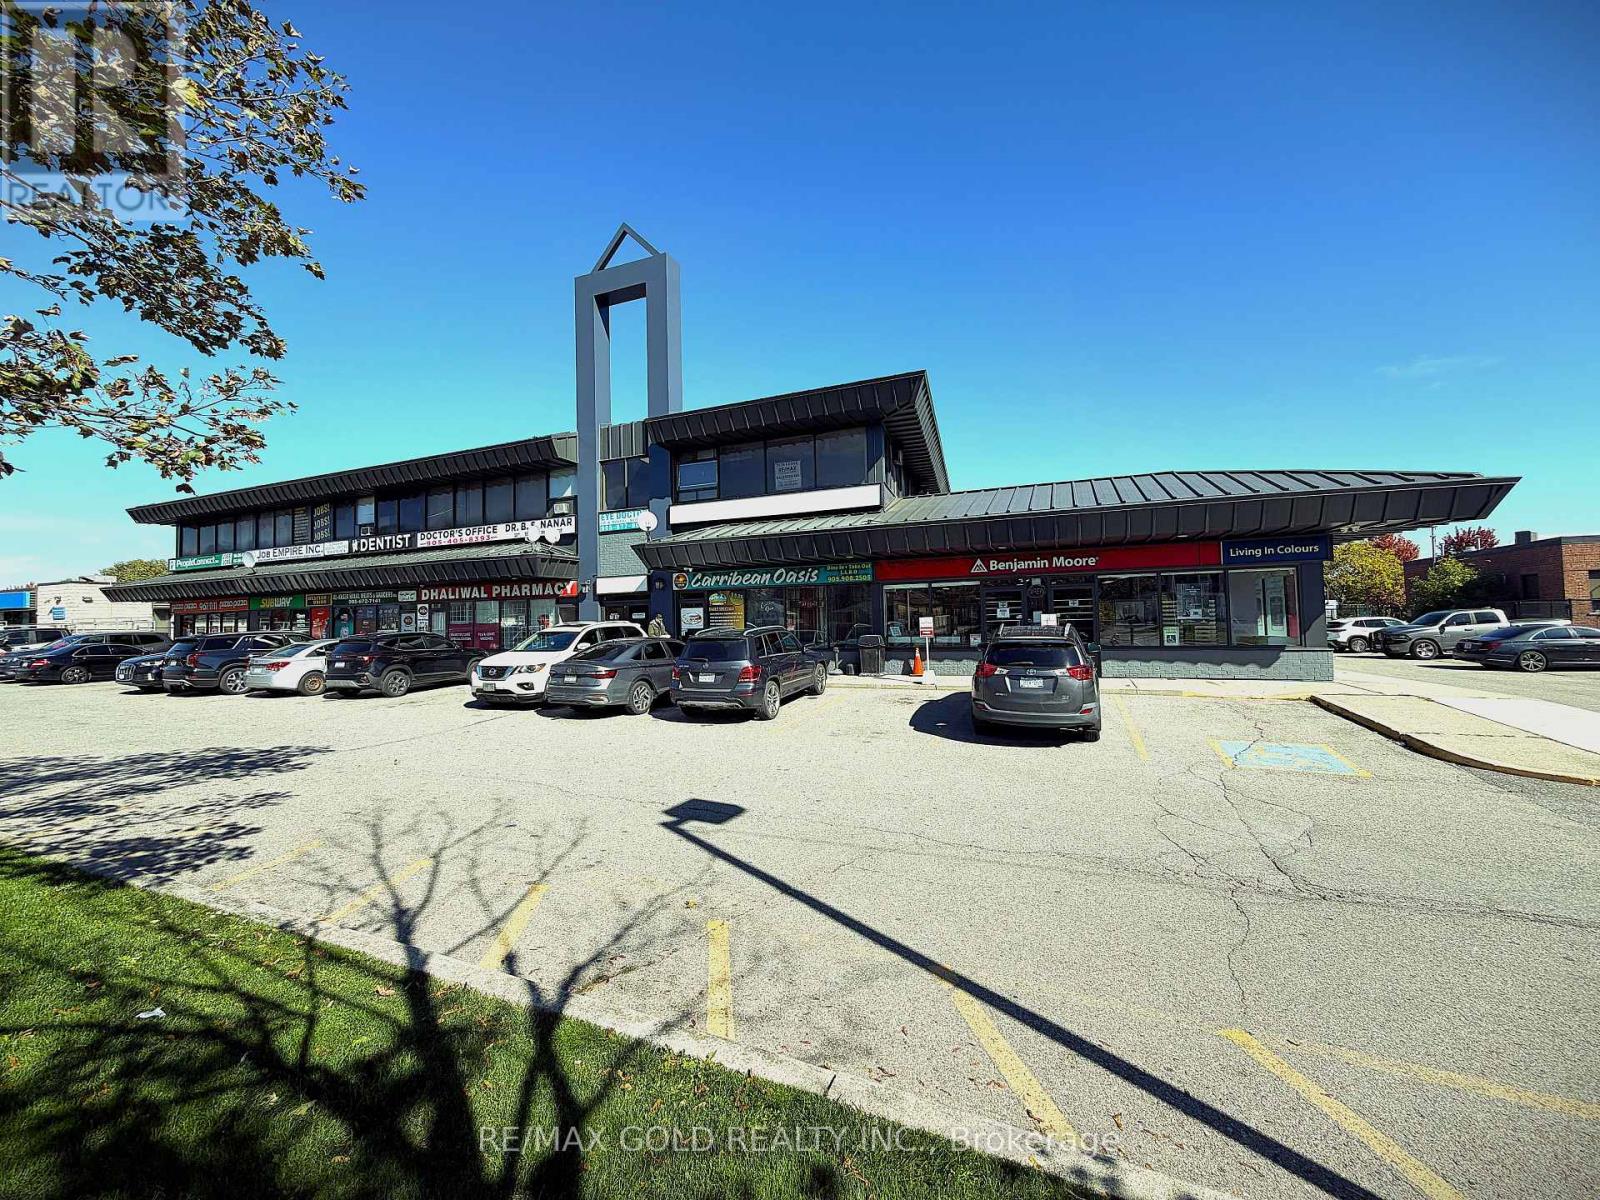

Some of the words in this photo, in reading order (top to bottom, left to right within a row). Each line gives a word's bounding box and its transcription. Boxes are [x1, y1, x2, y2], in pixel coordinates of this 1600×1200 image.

[313, 516, 330, 530] JOBS!
[420, 528, 463, 541] DOCTOR'S
[465, 525, 498, 536] OFFICE
[505, 523, 519, 532] DR.
[521, 522, 529, 530] B.
[540, 517, 573, 528] NANAR
[313, 528, 330, 541] JOBS!
[360, 533, 411, 552] DENTIST
[257, 550, 271, 559] JOB
[272, 546, 304, 558] EMPIRE
[1229, 547, 1262, 557] Living
[1264, 546, 1275, 554] In
[1277, 544, 1319, 554] Colours
[989, 557, 1049, 572] Benjamin
[1052, 556, 1096, 568] Moore
[691, 571, 770, 588] Carribean
[773, 567, 818, 583] Oasis
[421, 584, 488, 601] DHALIWAL
[492, 580, 576, 598] PHARMACY
[260, 596, 293, 608] SUBWAY
